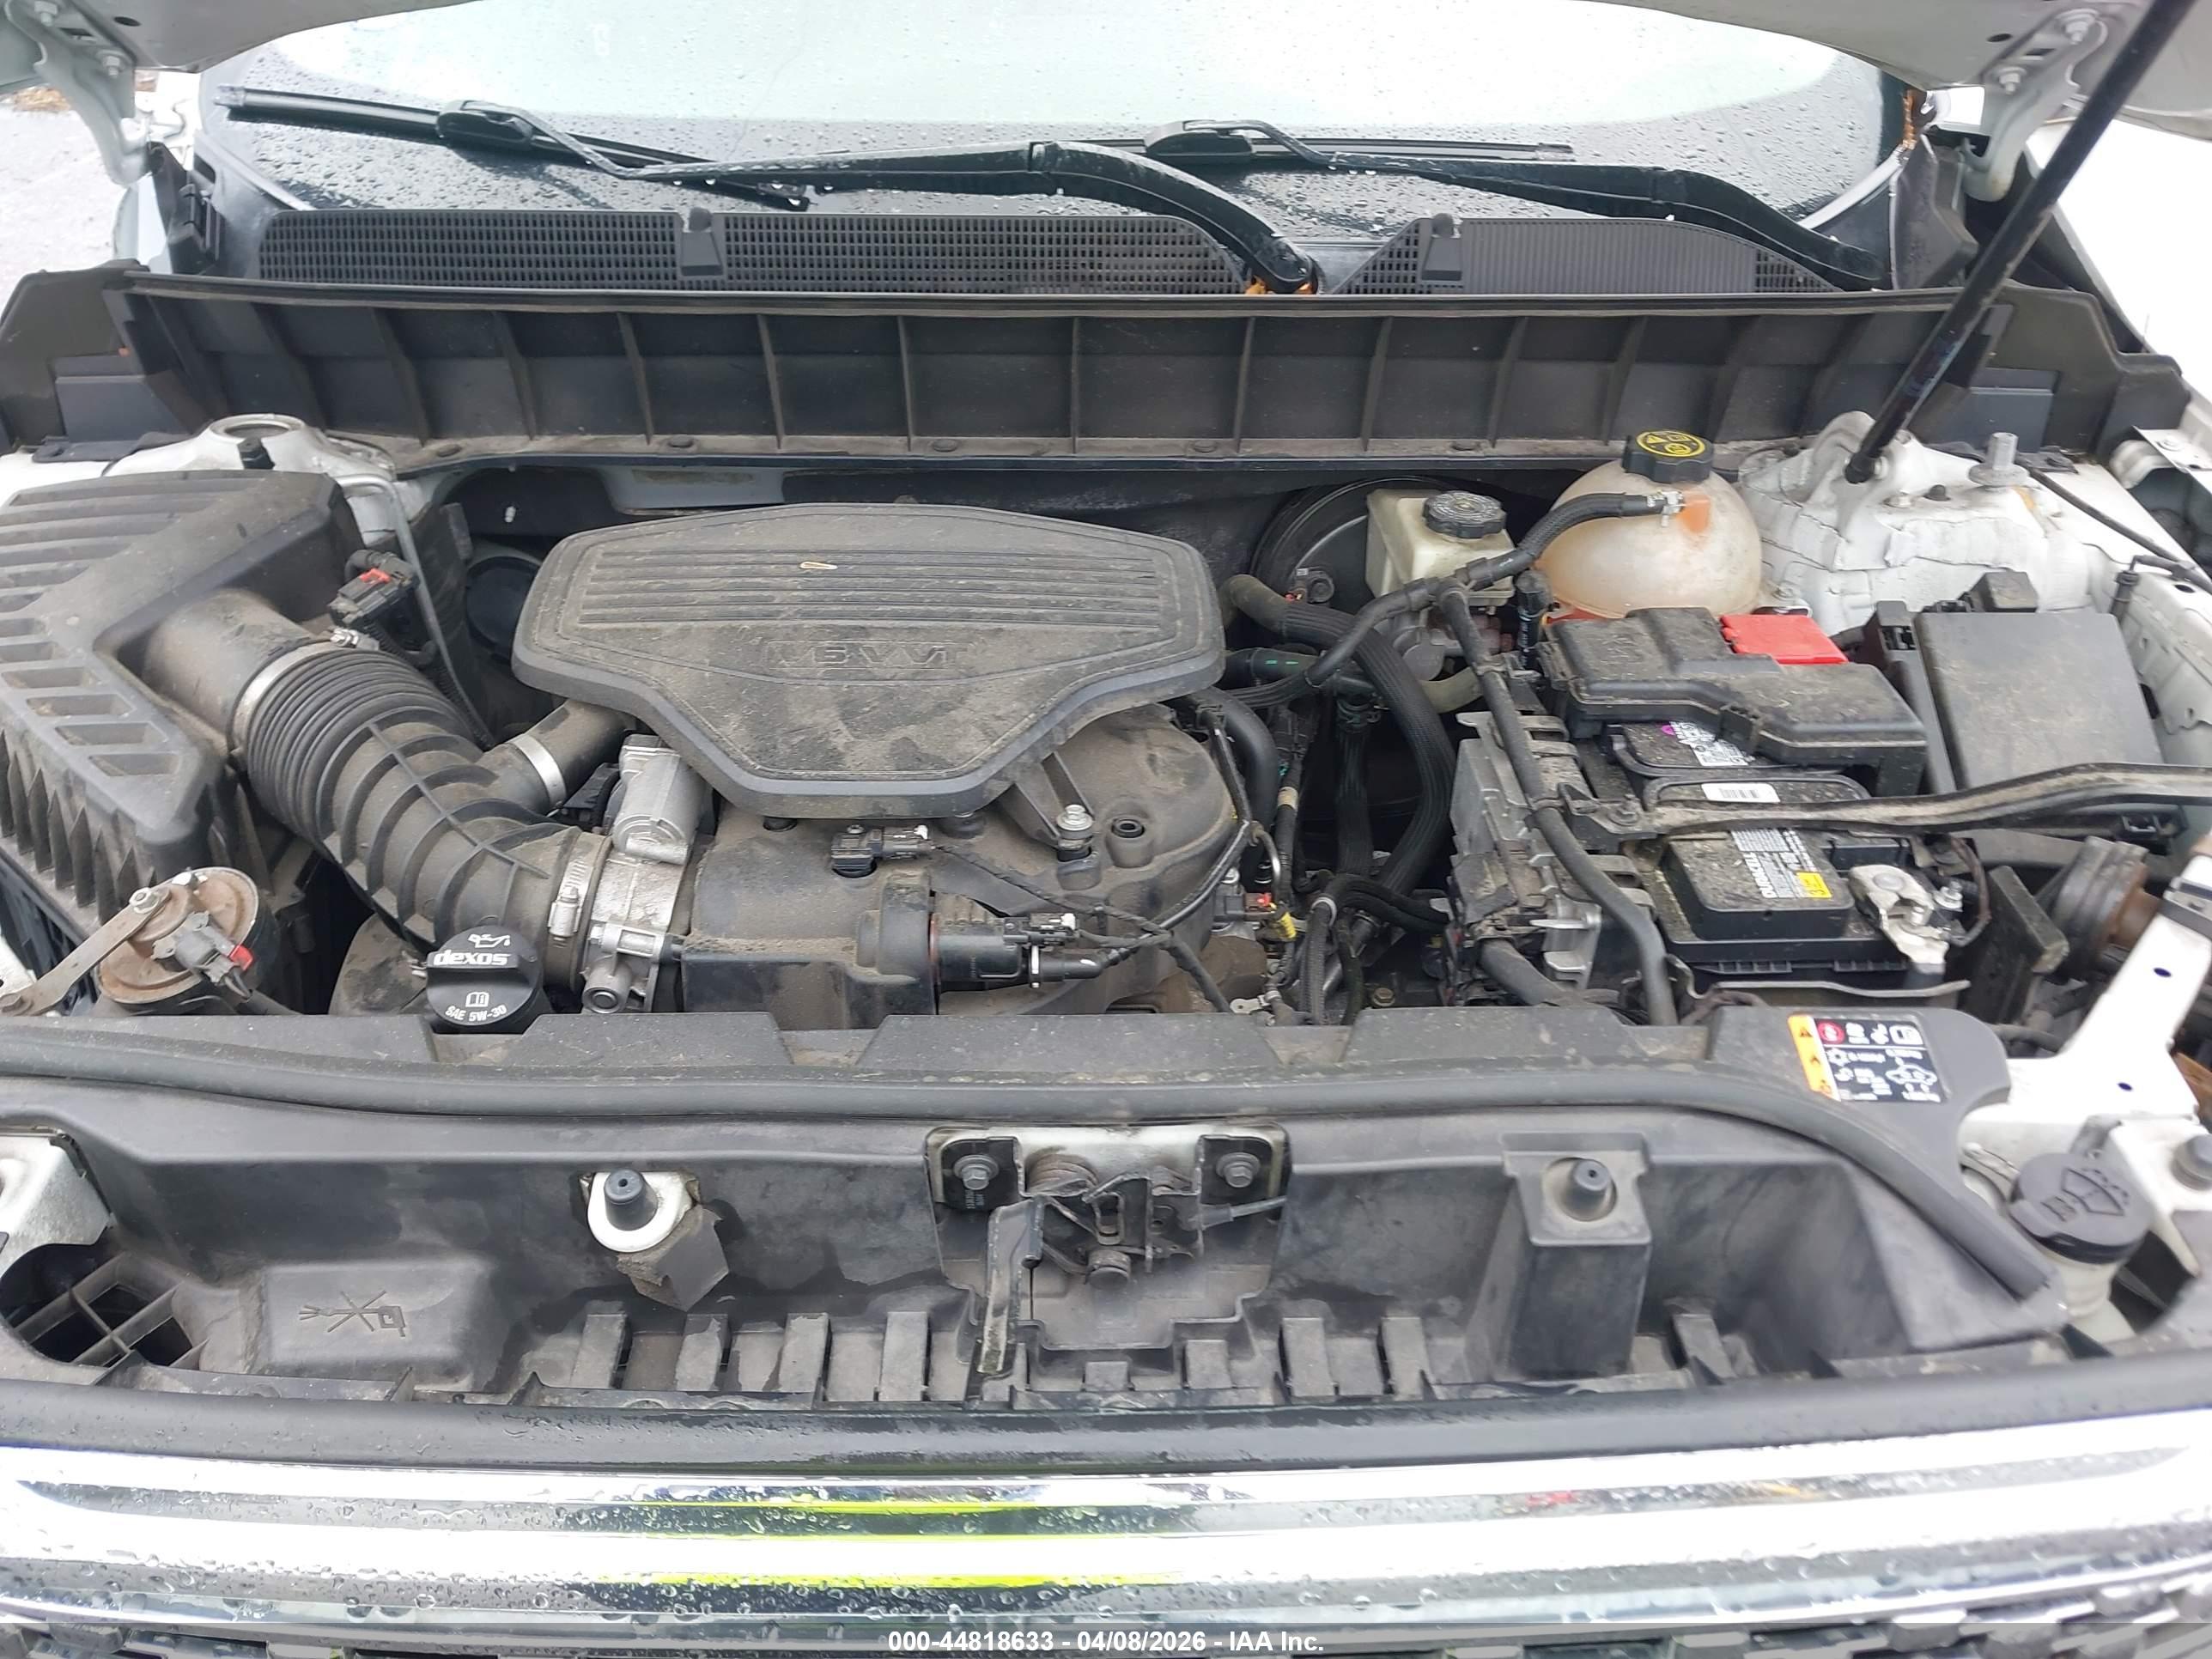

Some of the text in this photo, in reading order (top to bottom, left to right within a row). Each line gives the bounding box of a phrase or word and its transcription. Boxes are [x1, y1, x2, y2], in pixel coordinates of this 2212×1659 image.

[434, 950, 511, 965] dexos
[446, 1005, 507, 1021] SAE 5W-30
